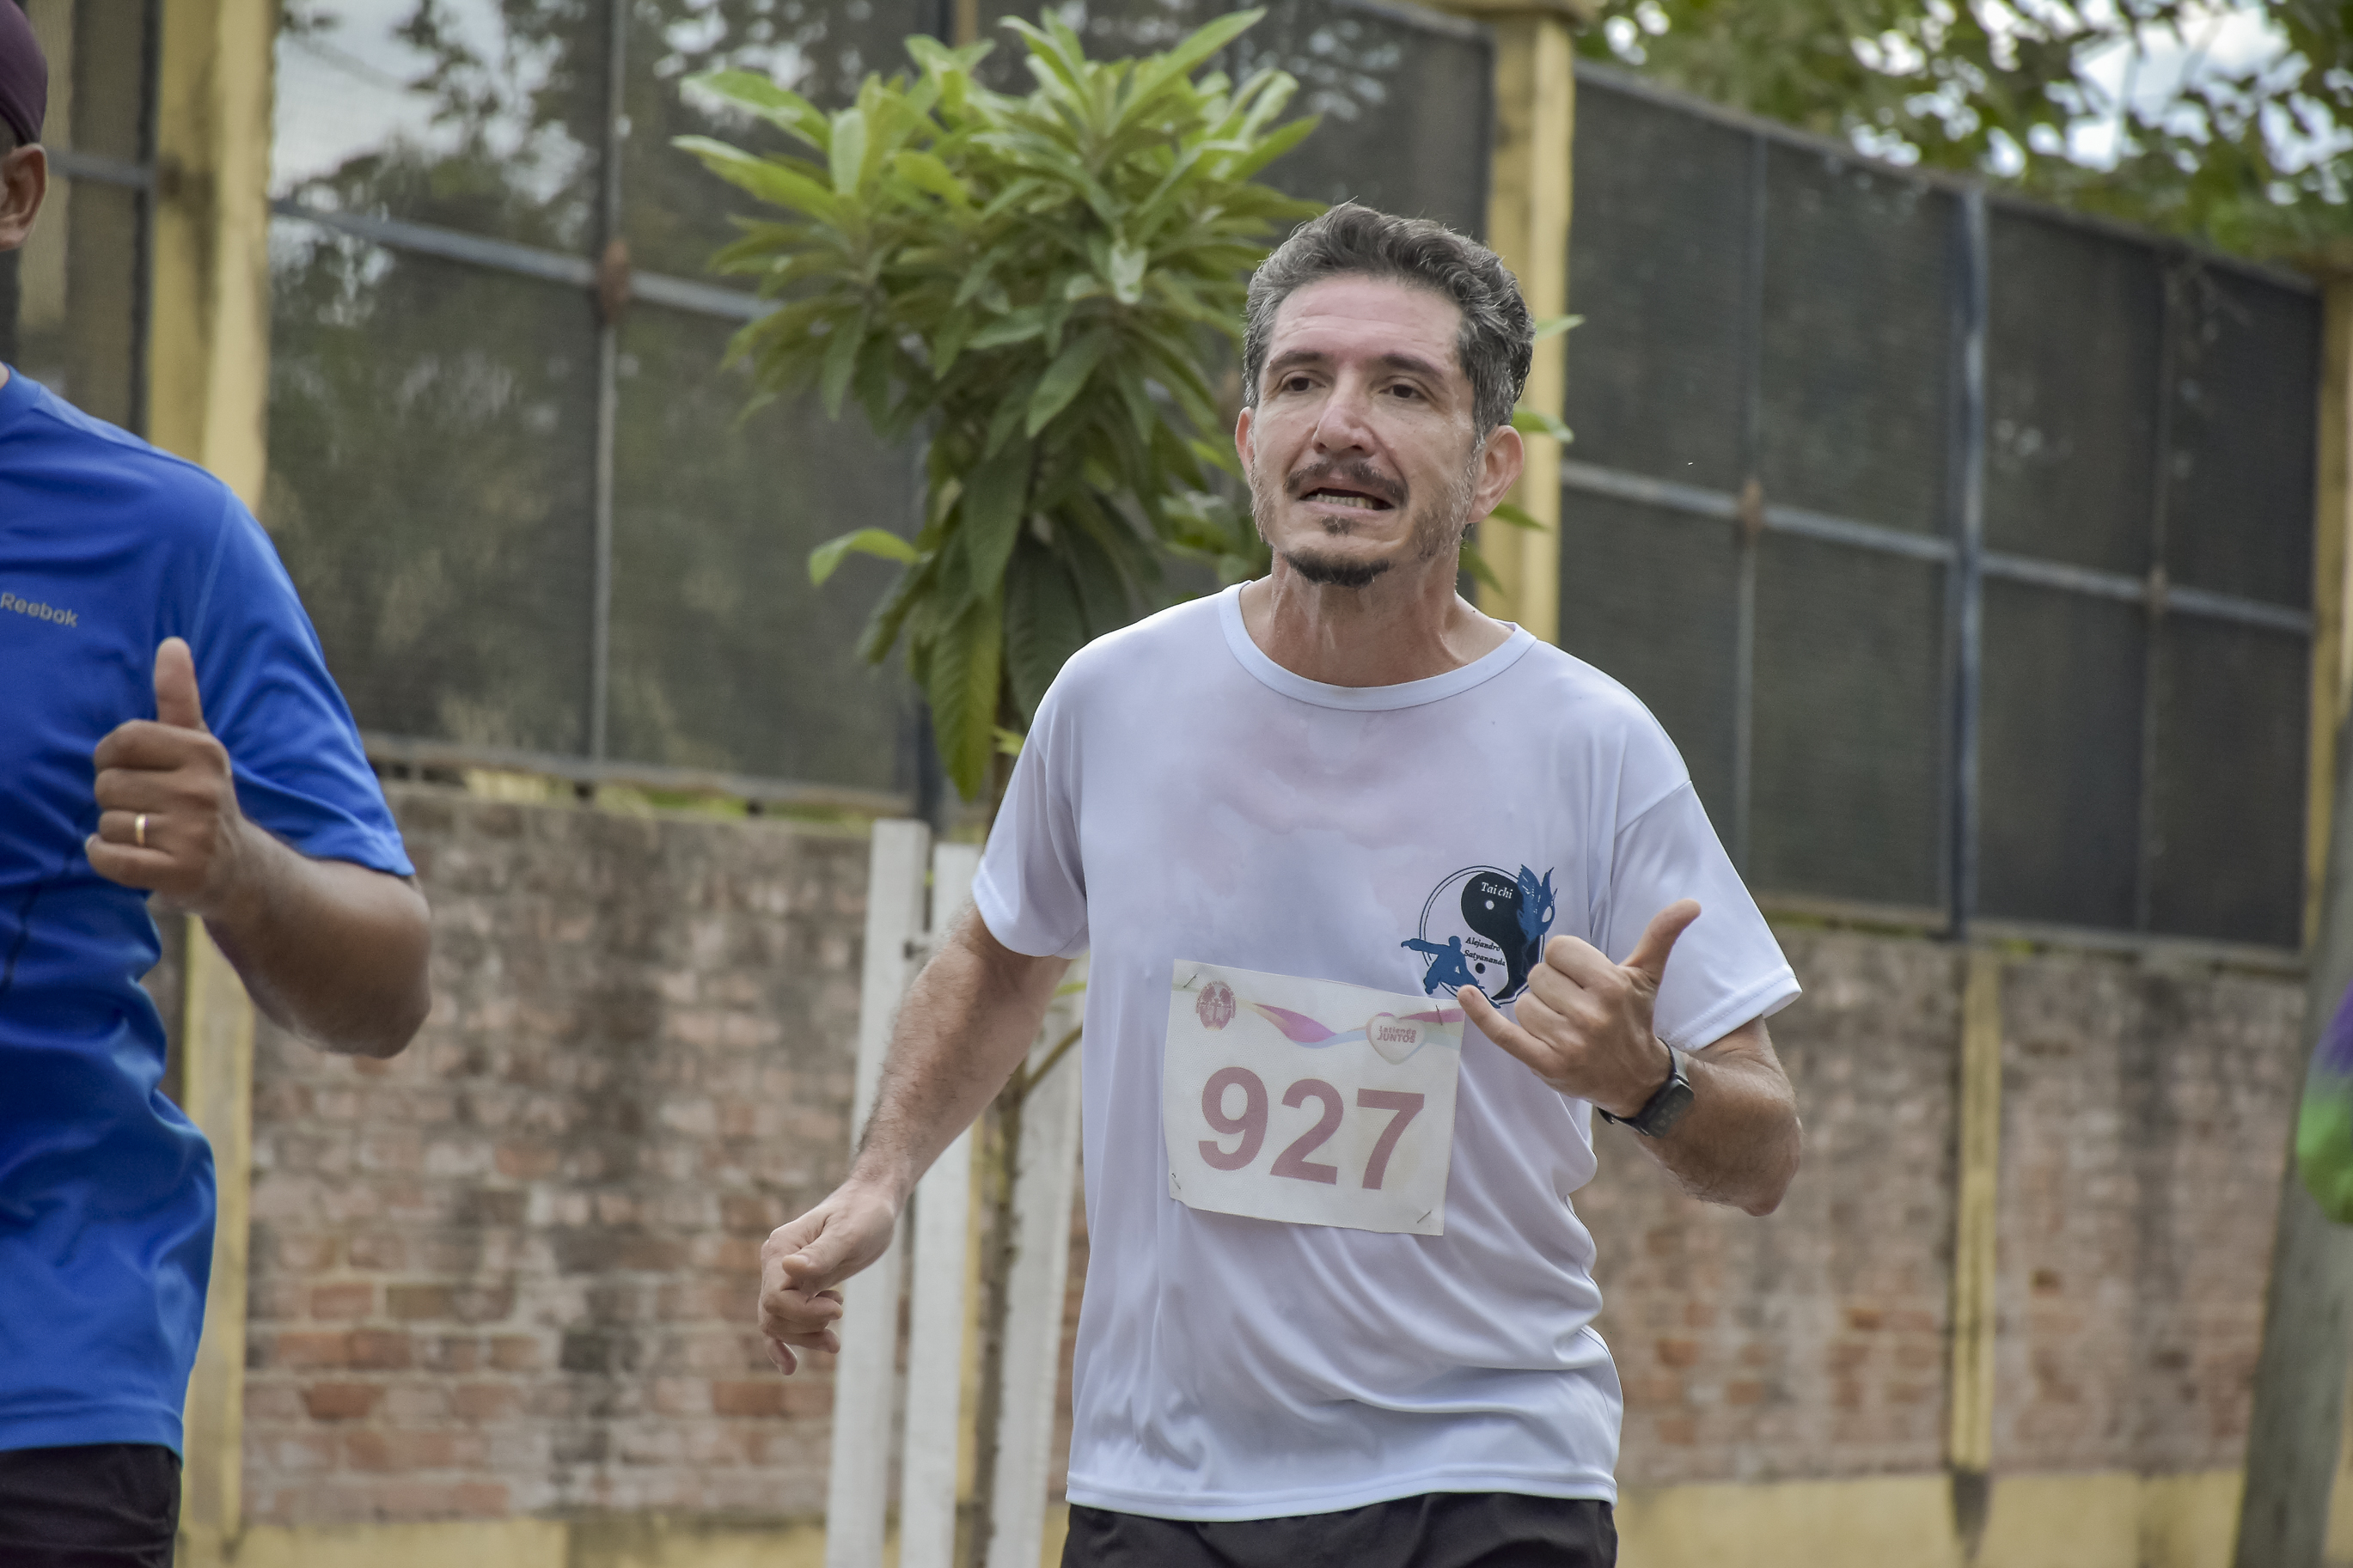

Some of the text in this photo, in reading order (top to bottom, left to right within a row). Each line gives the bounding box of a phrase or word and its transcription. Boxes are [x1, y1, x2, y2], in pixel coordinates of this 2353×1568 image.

[1, 592, 78, 628] Reebok
[1481, 882, 1513, 900] Tai chi
[1464, 937, 1500, 951] Alejandro
[1464, 949, 1507, 966] Satyananda
[1376, 1032, 1416, 1044] JUNTOS
[1198, 1066, 1425, 1191] 927
